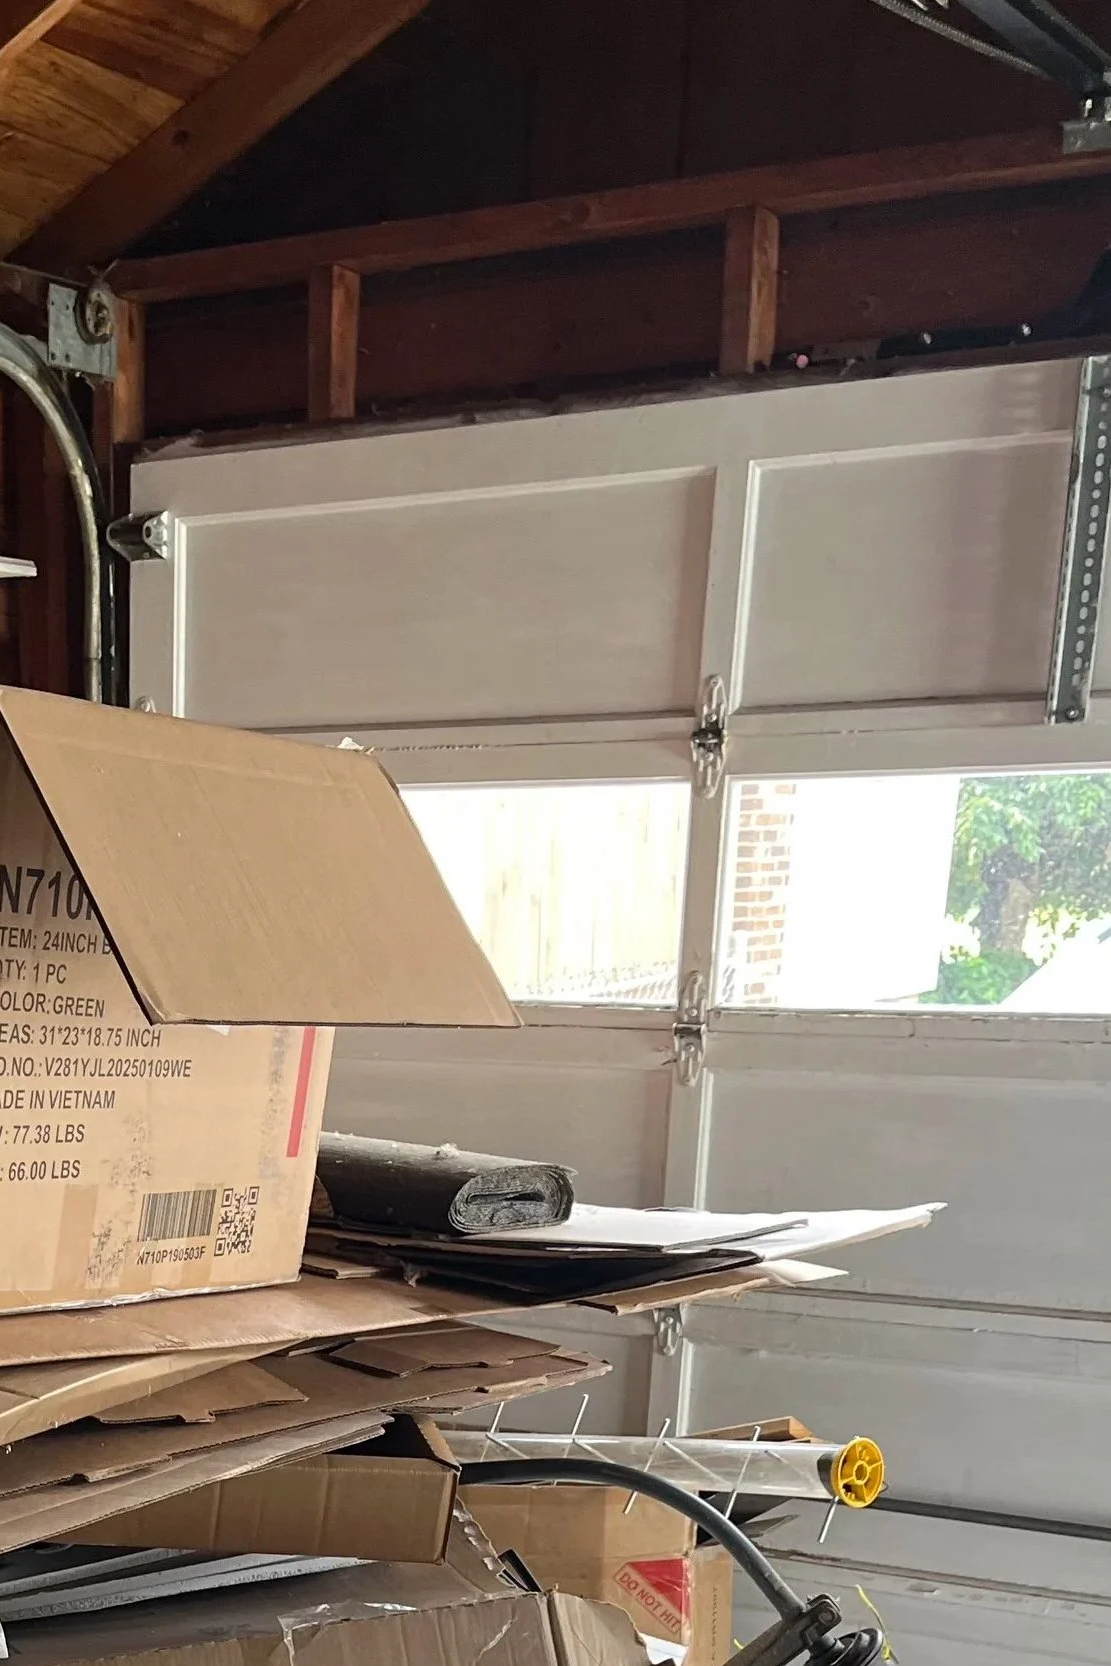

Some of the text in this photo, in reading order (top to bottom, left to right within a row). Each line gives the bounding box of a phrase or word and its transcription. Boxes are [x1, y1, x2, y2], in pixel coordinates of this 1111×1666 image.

[42, 930, 98, 955] 24INCH
[33, 961, 40, 984] 1
[45, 963, 68, 985] PC
[125, 1027, 162, 1049] INCH
[29, 1089, 45, 1110] IN
[48, 1089, 116, 1110] VIETNAM
[12, 1123, 51, 1145] 77.38
[55, 1122, 86, 1144] LBS
[7, 1160, 47, 1182] 66.00
[50, 1158, 81, 1180] LBS
[619, 1571, 682, 1629] DO NOT HIT
